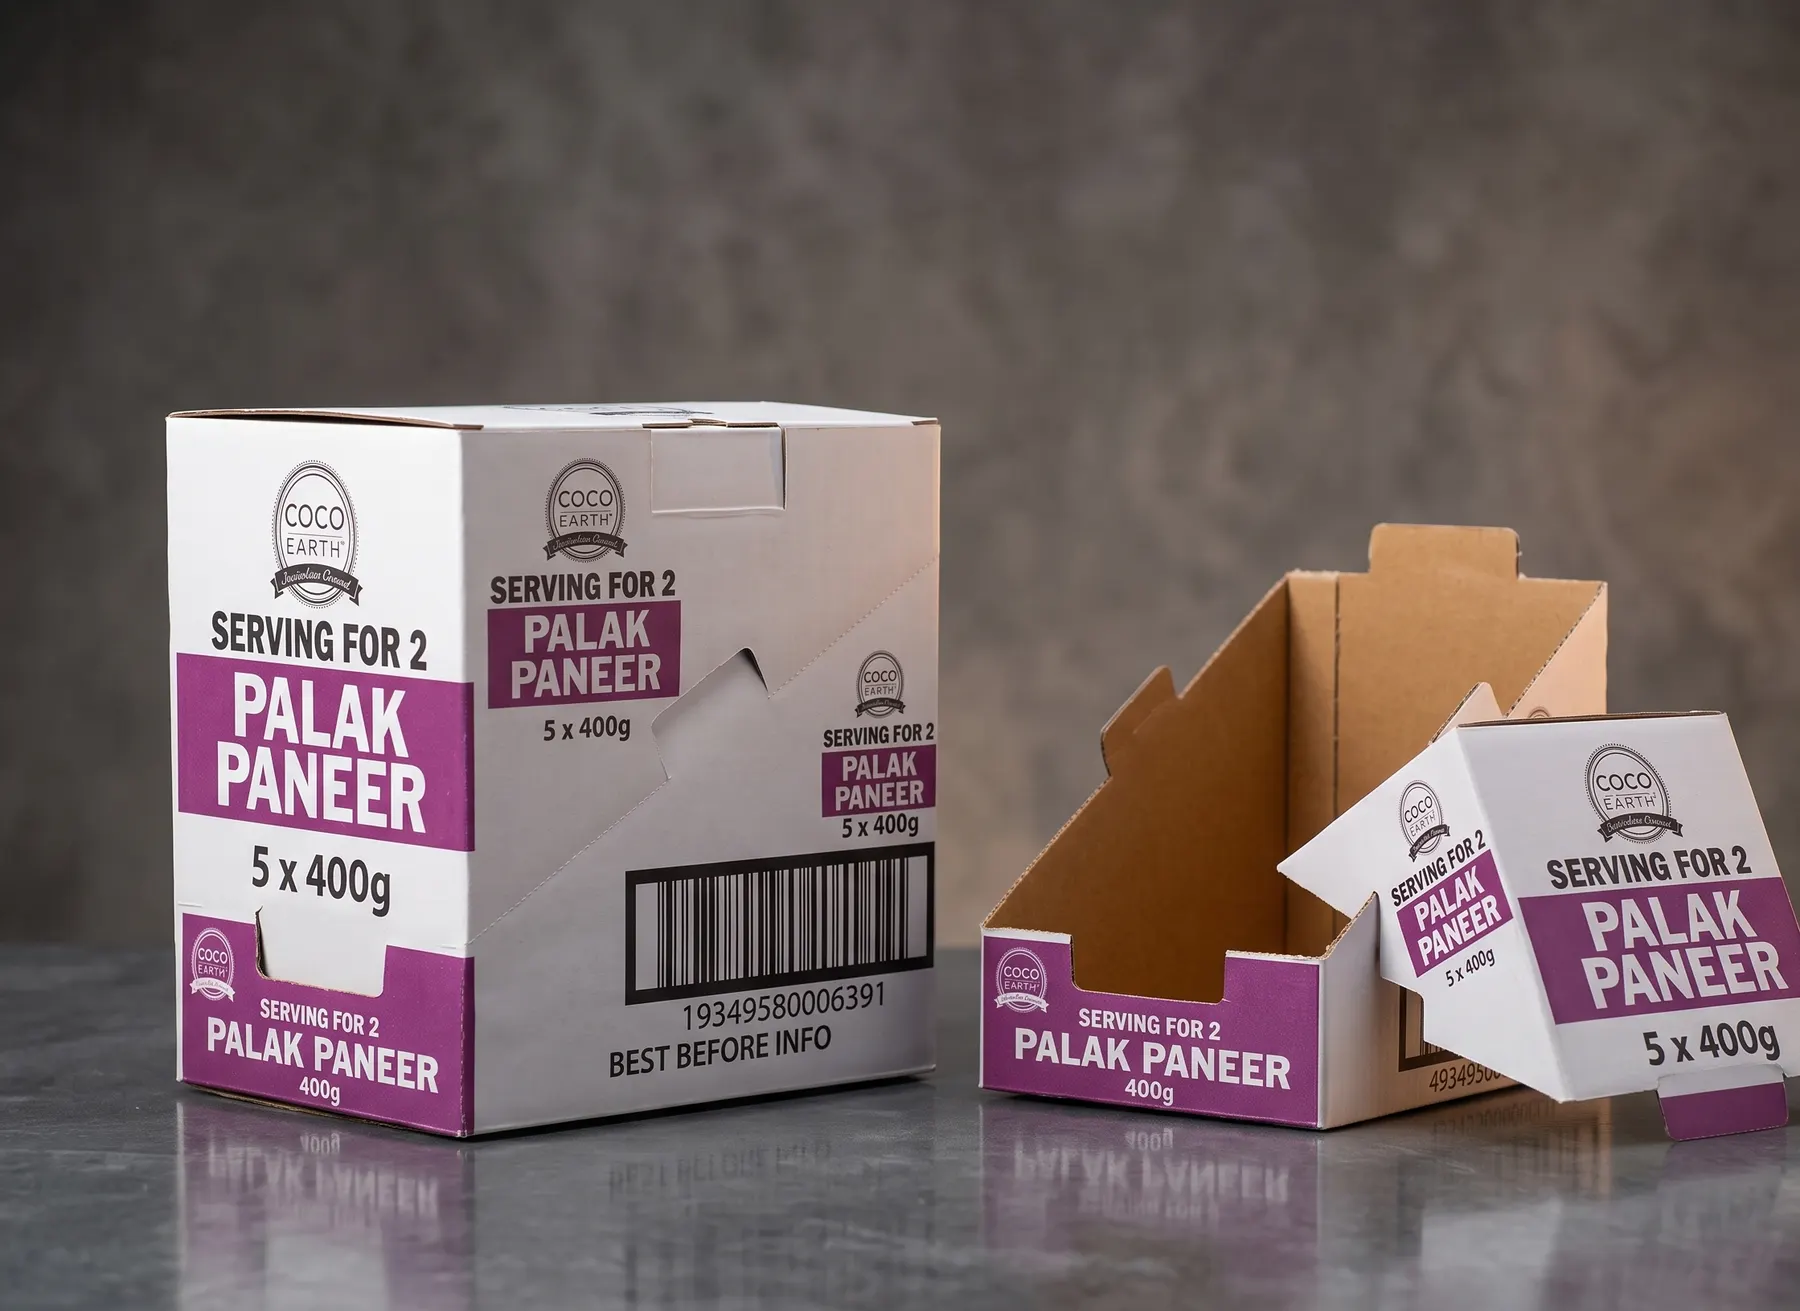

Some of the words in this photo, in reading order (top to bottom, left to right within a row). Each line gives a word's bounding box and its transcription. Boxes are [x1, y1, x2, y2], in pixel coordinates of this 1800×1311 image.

[285, 503, 344, 530] COCO
[558, 489, 613, 508] COCO
[490, 572, 600, 604] SERVING
[608, 570, 655, 599] FOR
[662, 569, 676, 596] 2
[211, 611, 333, 661] SERVING
[343, 624, 400, 668] FOR
[410, 630, 427, 671] 2
[524, 609, 650, 653] PALAK
[511, 653, 661, 699] PANEER
[864, 670, 897, 683] COCO
[234, 671, 409, 758] PALAK
[543, 719, 556, 741] 5
[562, 722, 574, 740] x
[579, 715, 631, 741] 400g
[823, 726, 889, 748] SERVING
[893, 723, 922, 743] FOR
[926, 722, 934, 740] 2
[842, 751, 917, 781] PALAK
[1596, 771, 1652, 792] COCO
[217, 740, 426, 833] PANEER
[835, 780, 924, 811] PANEER
[842, 818, 852, 838] 5
[858, 821, 868, 837] x
[873, 813, 919, 837] 400g
[1404, 796, 1433, 823] COCO
[252, 845, 269, 888] 5
[279, 858, 298, 893] x
[306, 854, 391, 917] 400g
[1391, 857, 1448, 907] SERVING
[1447, 837, 1475, 870] FOR
[1475, 829, 1486, 850] 2
[1546, 851, 1669, 890] SERVING
[1678, 847, 1728, 879] FOR
[1731, 845, 1753, 874] 2
[1413, 865, 1485, 932] PALAK
[1417, 895, 1502, 967] PANEER
[1581, 889, 1758, 952] PALAK
[198, 948, 228, 964] COCO
[1004, 966, 1039, 980] COCO
[1445, 970, 1454, 987] 5
[1455, 967, 1465, 982] x
[1466, 949, 1495, 976] 400g
[1581, 940, 1789, 1010] PANEER
[260, 998, 328, 1029] SERVING
[333, 1010, 364, 1035] FOR
[368, 1017, 379, 1038] 2
[683, 981, 885, 1031] 19349580006391
[1078, 1007, 1160, 1035] SERVING
[1166, 1017, 1203, 1039] FOR
[1209, 1021, 1221, 1041] 2
[207, 1017, 304, 1069] PALAK
[314, 1036, 439, 1094] PANEER
[610, 1045, 670, 1078] BEST
[677, 1032, 769, 1069] BEFORE
[776, 1024, 832, 1056] INFO
[1015, 1027, 1131, 1073] PALAK
[1143, 1042, 1291, 1090] PANEER
[1643, 1030, 1664, 1066] 5
[1670, 1035, 1695, 1063] x
[1699, 1019, 1781, 1060] 400g
[299, 1076, 340, 1106] 400g
[1125, 1078, 1174, 1106] 400g
